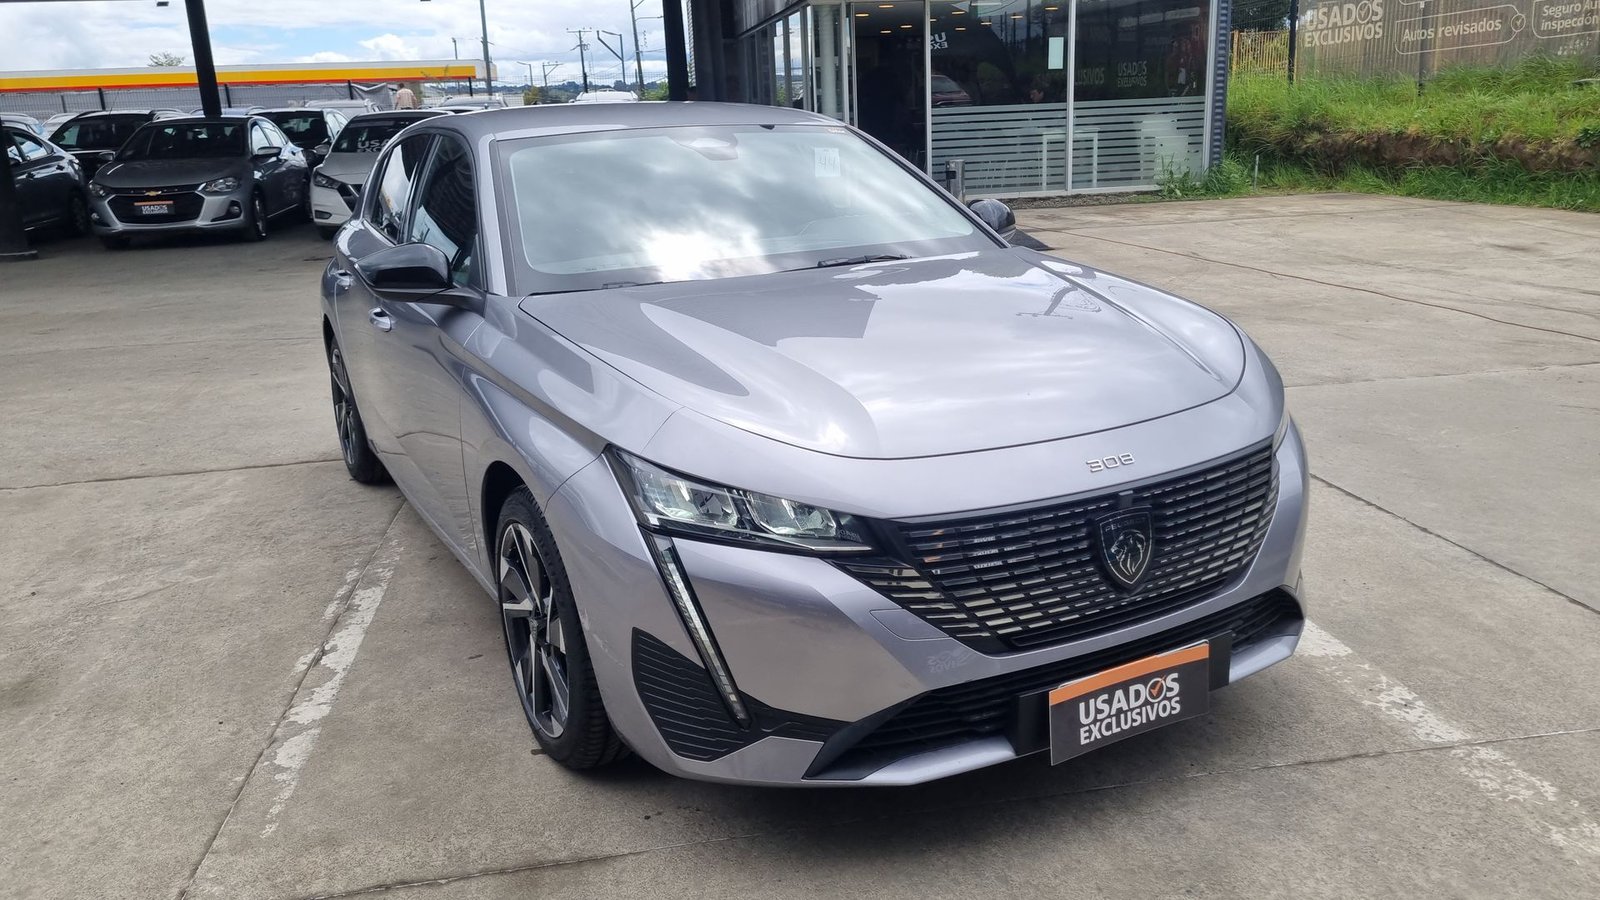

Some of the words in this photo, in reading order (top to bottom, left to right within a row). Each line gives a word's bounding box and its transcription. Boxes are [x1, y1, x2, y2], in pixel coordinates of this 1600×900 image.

[1305, 0, 1383, 31] USADOS
[1542, 3, 1581, 18] Seguro
[1304, 22, 1383, 47] EXCLUSIVOS
[1402, 28, 1435, 42] Autos
[1438, 18, 1502, 37] revisados
[1086, 452, 1135, 473] 308
[1079, 673, 1180, 725] USADOS
[1079, 696, 1181, 745] EXCLUSIVOS
